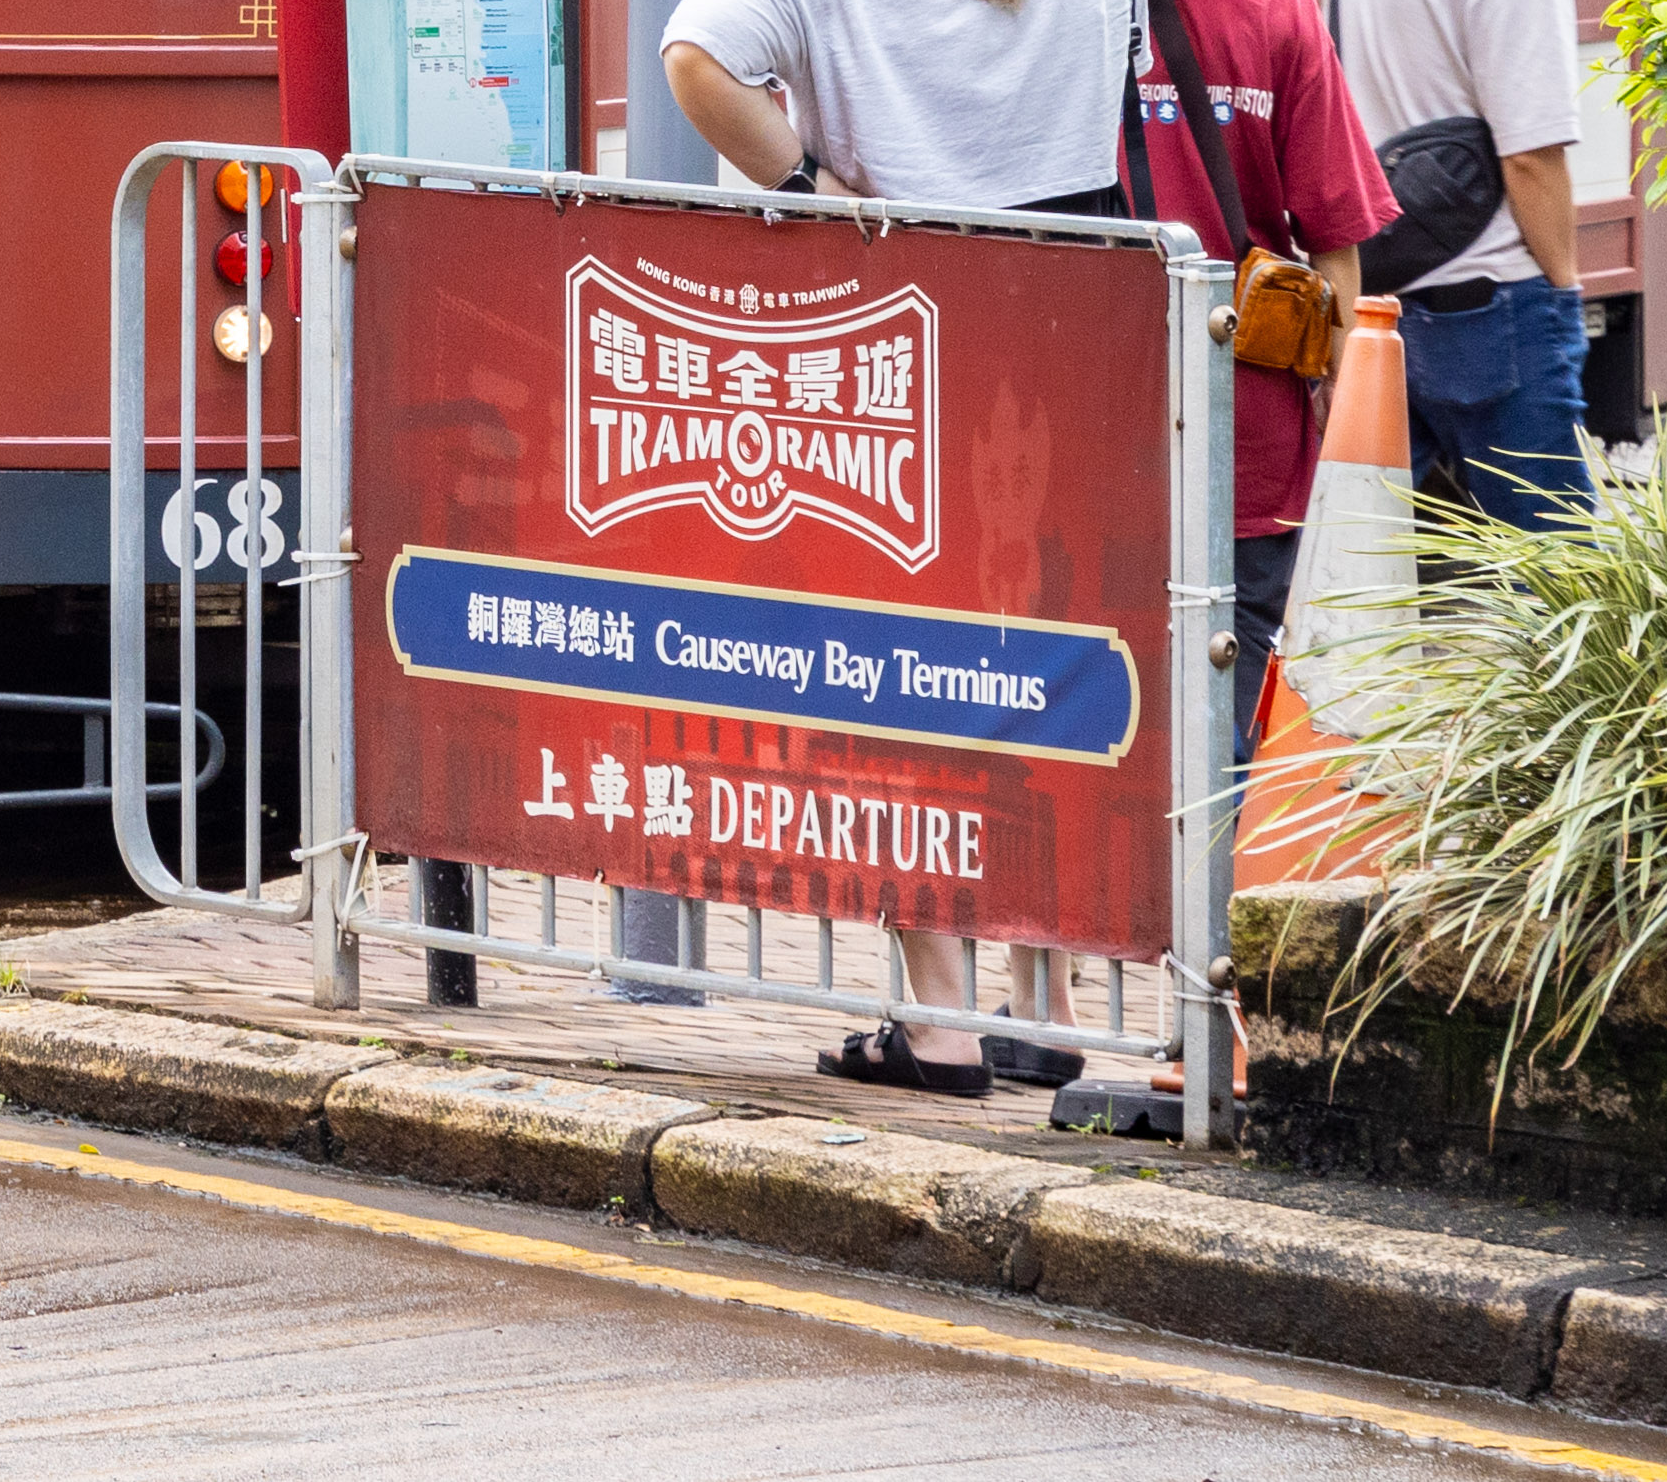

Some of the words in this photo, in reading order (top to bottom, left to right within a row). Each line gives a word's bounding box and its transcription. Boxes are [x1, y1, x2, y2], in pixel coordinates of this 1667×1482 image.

[1138, 83, 1179, 102] GKONG
[1206, 85, 1233, 105] ING
[636, 257, 671, 284] HONG
[673, 275, 706, 297] KONG
[709, 286, 734, 305] 香港
[763, 292, 790, 309] 電車
[792, 279, 860, 306] TRAMWAYS
[590, 308, 913, 421] 電車全景遊
[590, 407, 916, 524] TRAMORAMIC
[715, 464, 788, 509] TOUR
[161, 478, 286, 571] 68
[467, 592, 636, 663] 銅鑼灣總站
[655, 619, 815, 694] Causeway
[824, 640, 885, 703] Bay
[893, 647, 1047, 712] Terminus
[523, 747, 693, 839] 上車點
[709, 777, 984, 881] DEPARTURE
